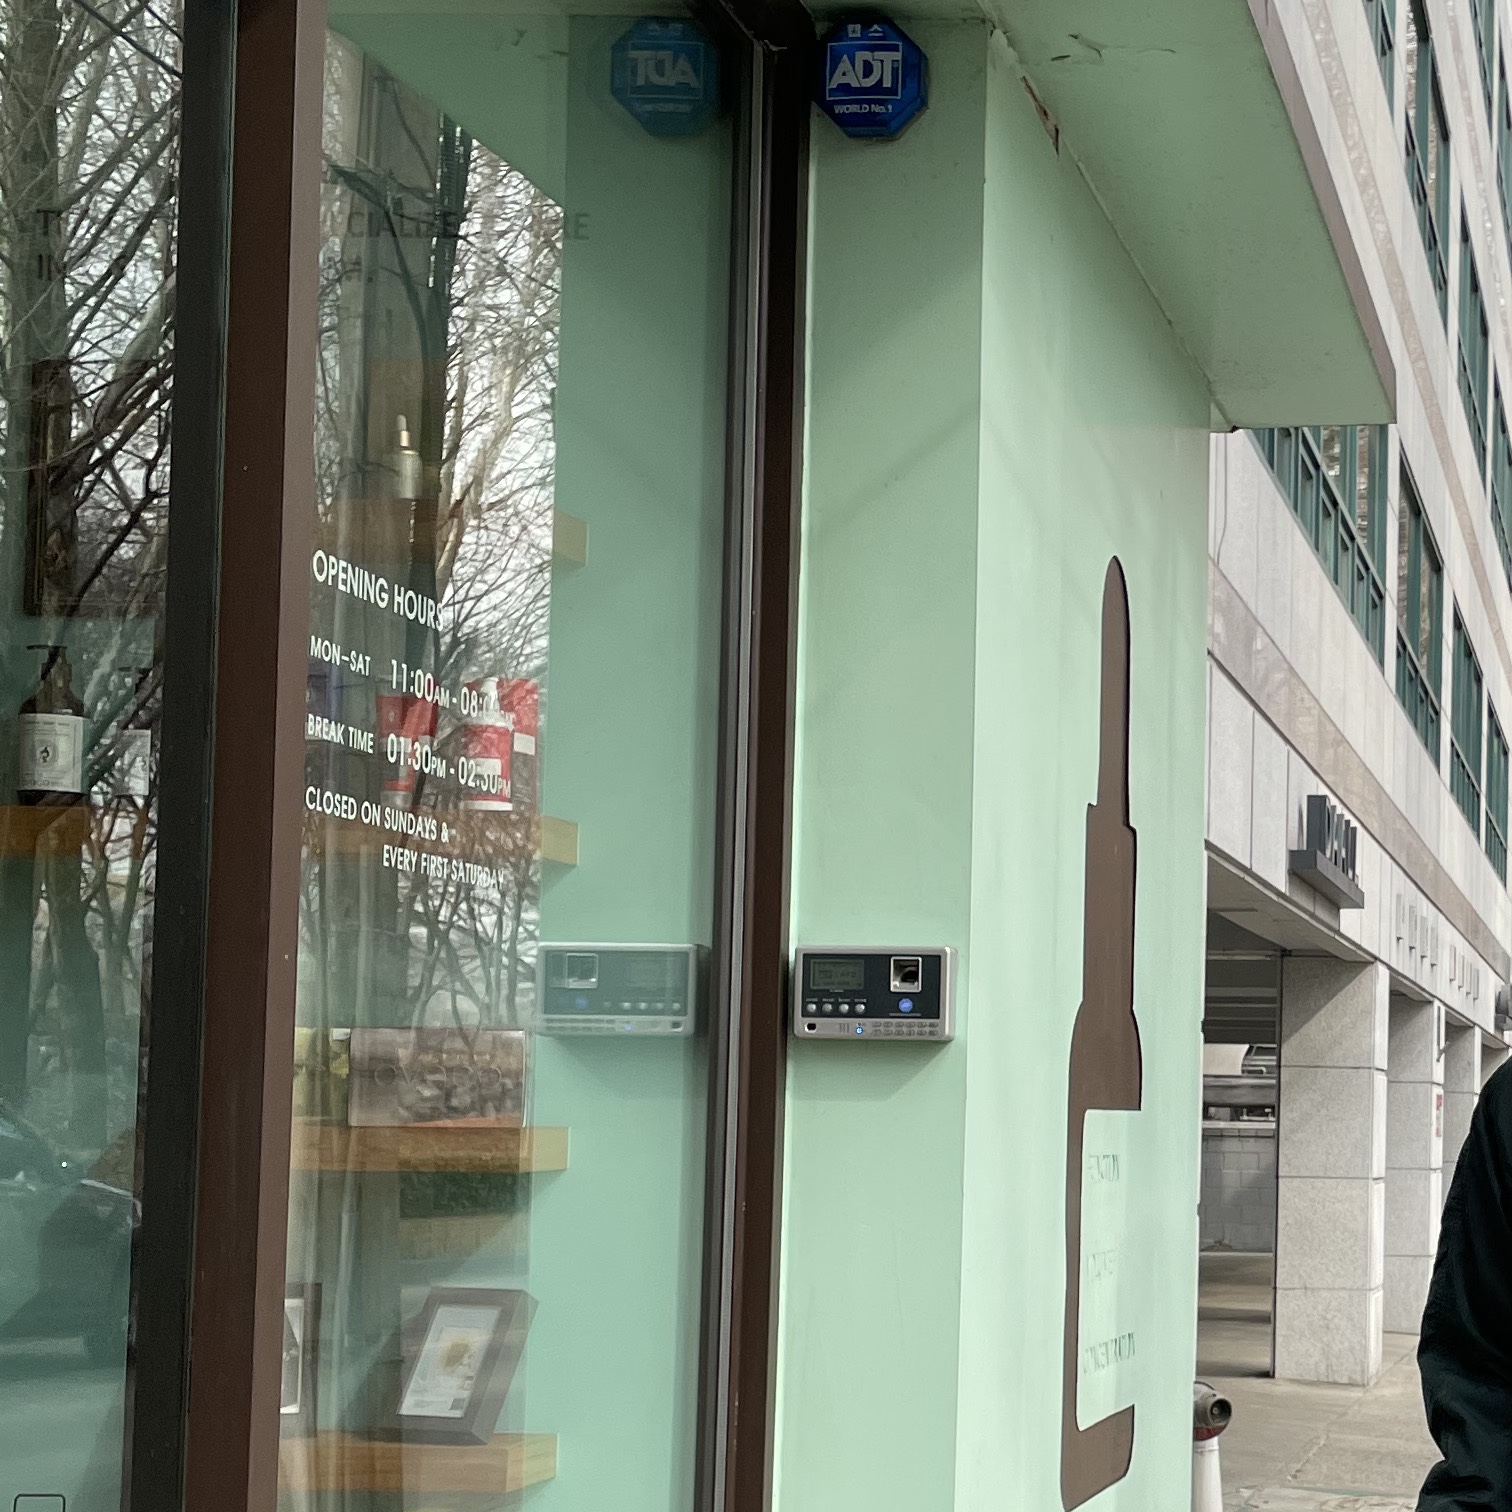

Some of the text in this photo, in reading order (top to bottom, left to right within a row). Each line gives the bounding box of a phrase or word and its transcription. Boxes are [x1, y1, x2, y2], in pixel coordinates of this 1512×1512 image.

[829, 51, 900, 89] ADT
[834, 104, 869, 115] WORLD
[312, 549, 445, 632] OPENING HOURS
[391, 659, 450, 709] 11:00AM
[307, 713, 345, 746] BREAK
[348, 726, 374, 755] TIME
[387, 733, 446, 779] 01:30PM
[305, 785, 449, 843] CLOSED ON SUNDAYS &
[382, 844, 504, 891] EVERY FIRST SATURDAY
